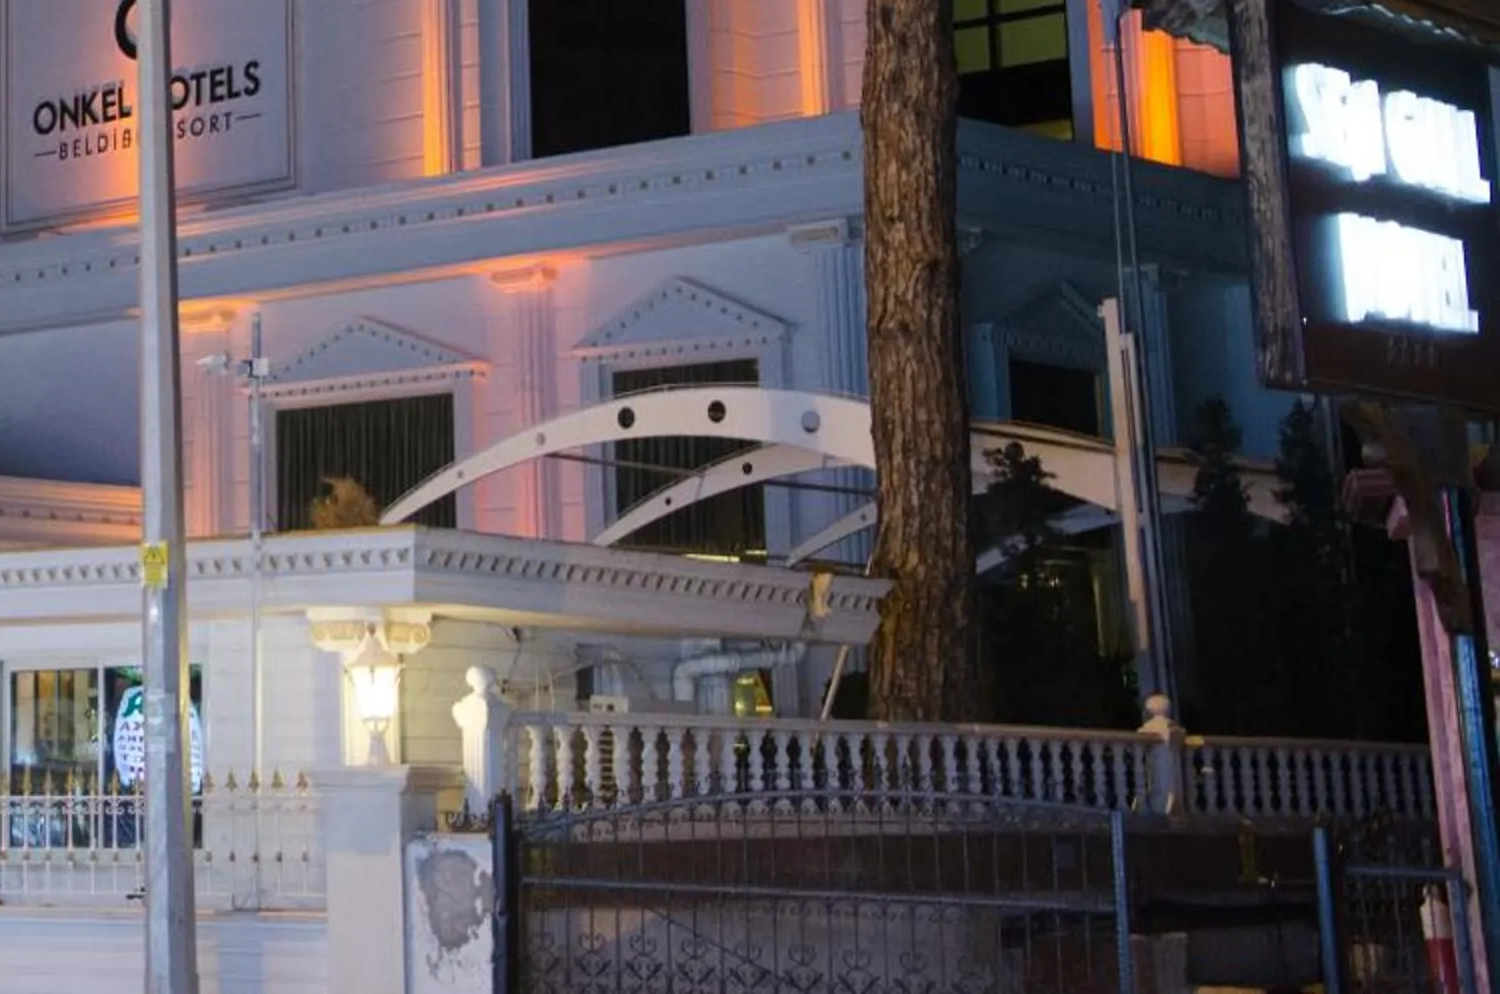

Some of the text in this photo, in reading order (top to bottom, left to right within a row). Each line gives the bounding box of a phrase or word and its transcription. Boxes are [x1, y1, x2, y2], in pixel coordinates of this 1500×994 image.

[33, 60, 261, 135] ONKEL OTELS
[58, 111, 234, 161] BELDİB SORT
